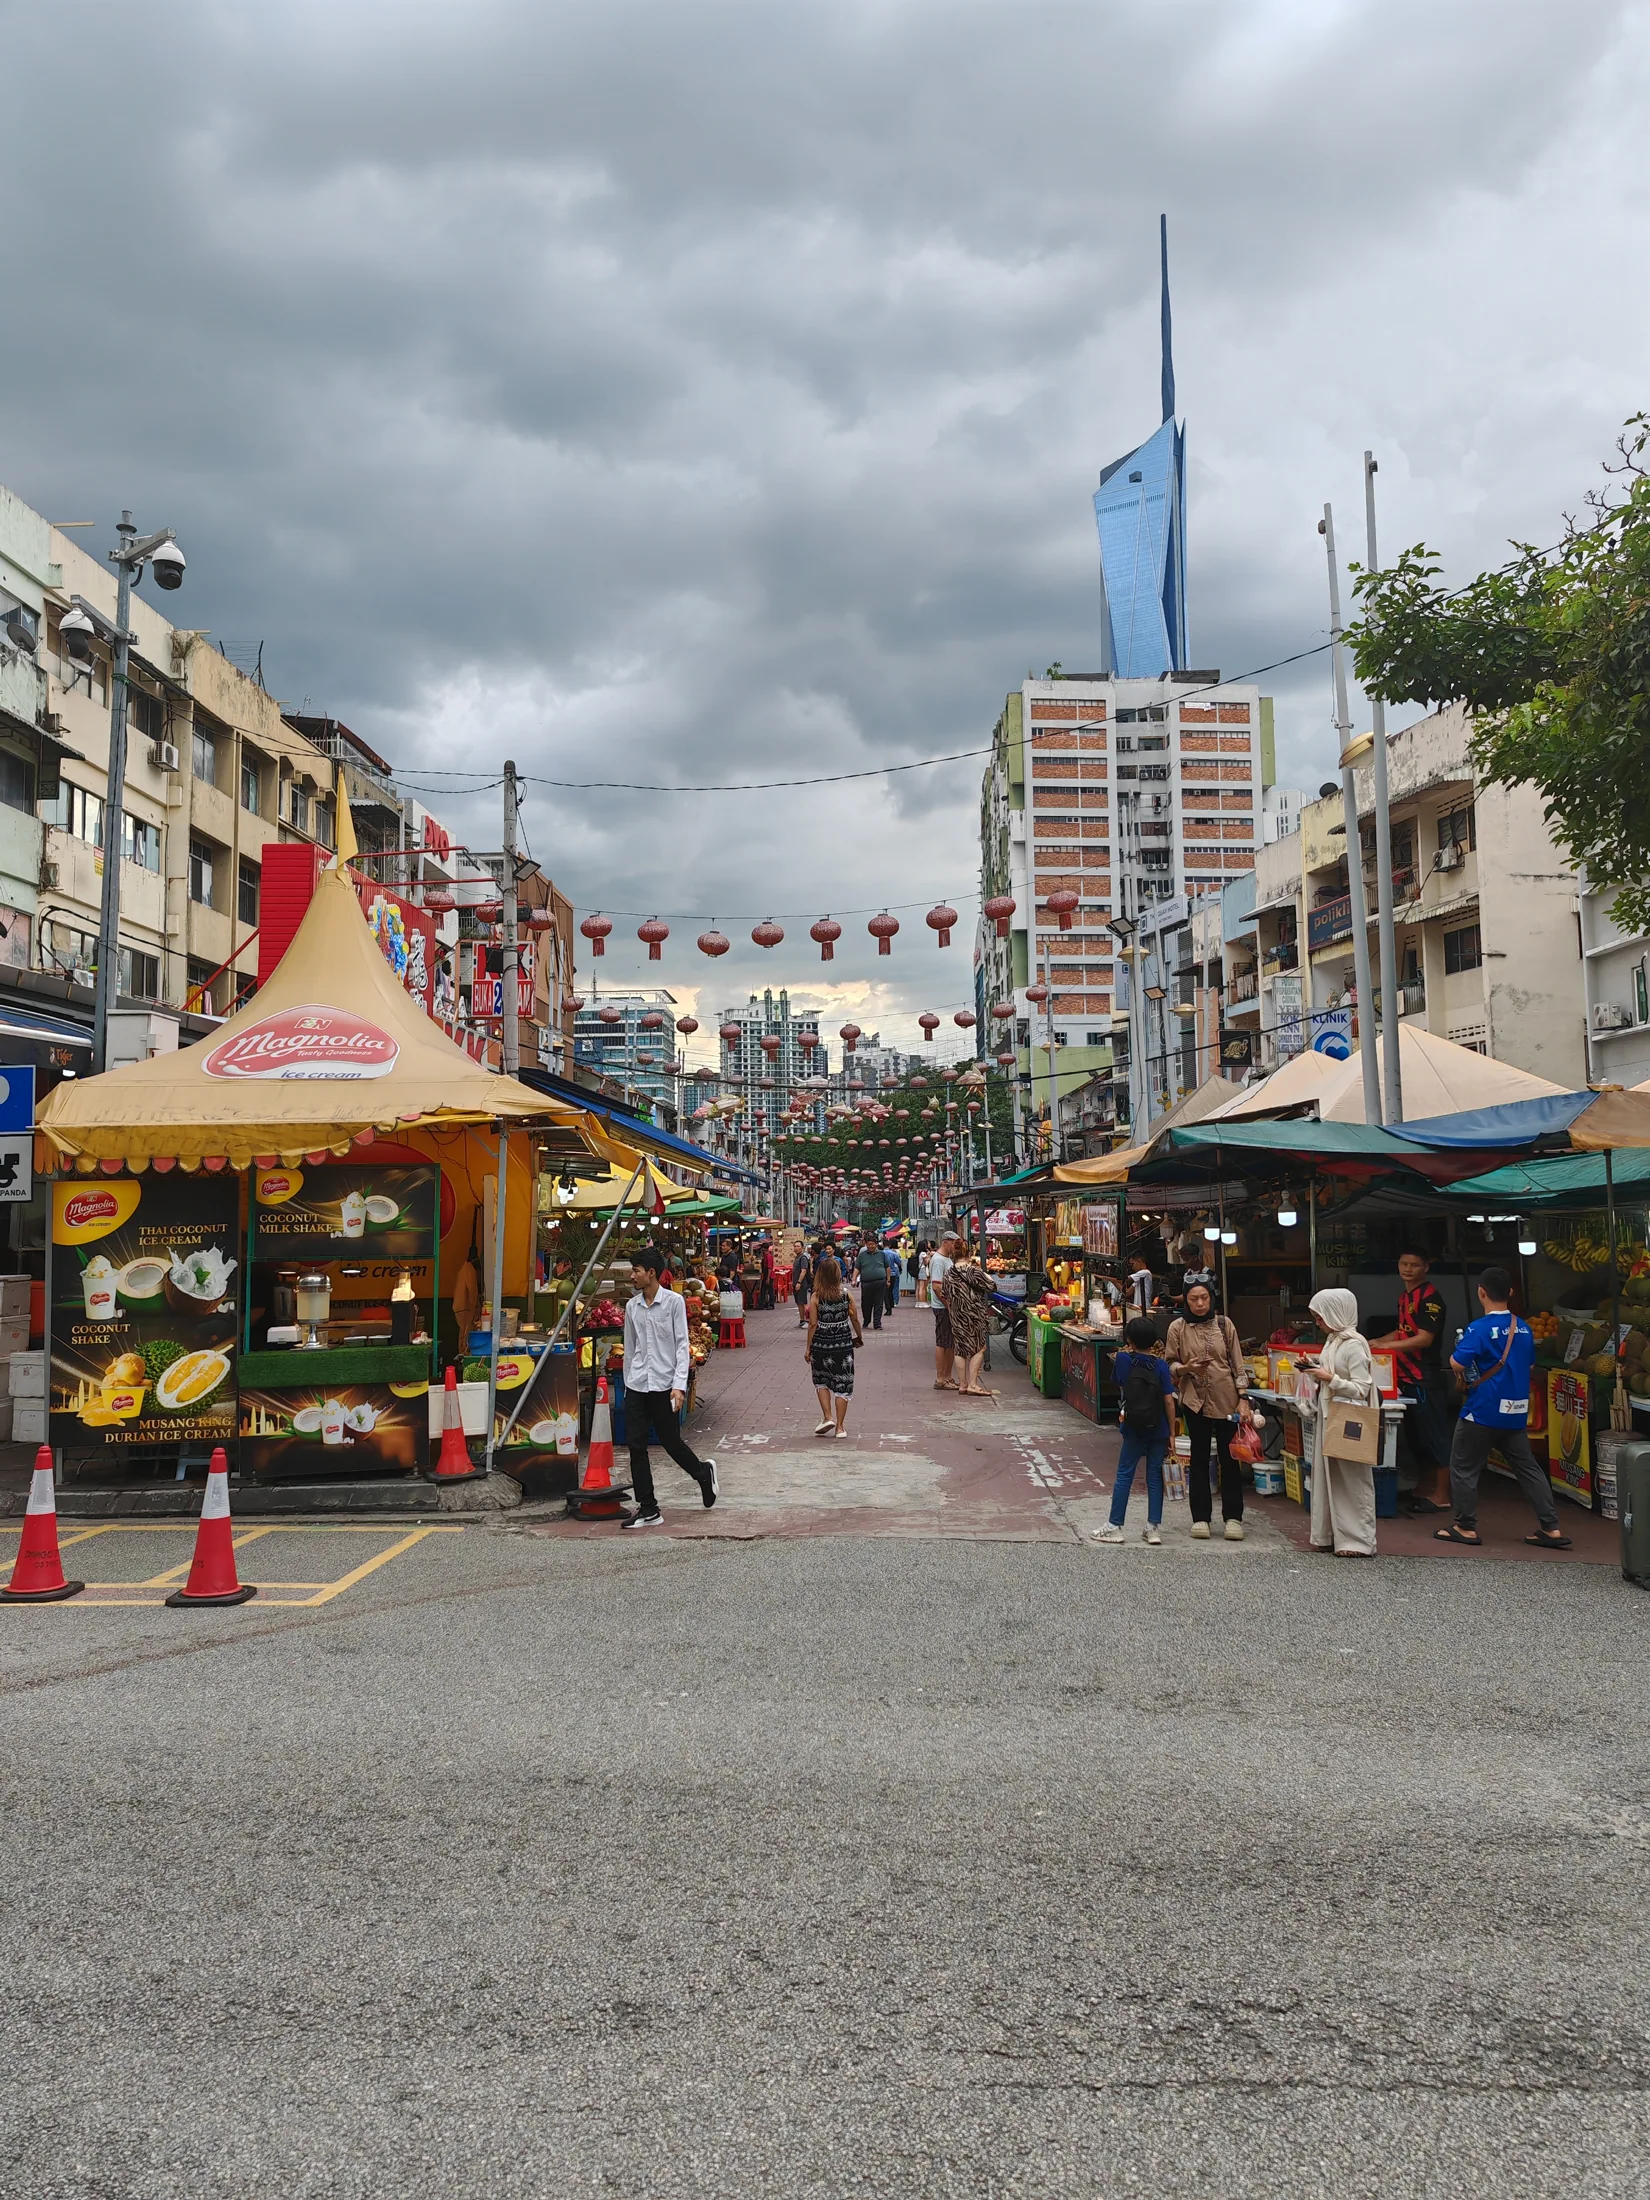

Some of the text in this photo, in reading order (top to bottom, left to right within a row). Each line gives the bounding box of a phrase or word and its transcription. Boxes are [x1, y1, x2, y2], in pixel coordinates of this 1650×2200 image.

[1314, 902, 1351, 930] polikli
[474, 983, 493, 1012] BUKA
[1312, 1013, 1348, 1023] KLINIK
[1280, 1025, 1300, 1033] ANN
[224, 1031, 386, 1058] Magnolia
[56, 1049, 73, 1065] Tiger
[280, 1069, 305, 1078] ice
[917, 1190, 929, 1198] KK
[69, 1199, 115, 1217] Magnolia
[259, 1214, 320, 1223] COCONUT
[139, 1223, 228, 1236] THAI COCONUT
[259, 1224, 334, 1233] MILK SHAKE
[139, 1236, 202, 1246] ICE CREAM
[71, 1324, 131, 1334] COCONUT
[71, 1335, 110, 1345] SHAKE
[139, 1416, 231, 1429] MUSANG KING
[105, 1429, 232, 1443] DURIAN ICE CREAM
[1558, 1458, 1585, 1479] MUSANG
[1565, 1472, 1580, 1488] KING
